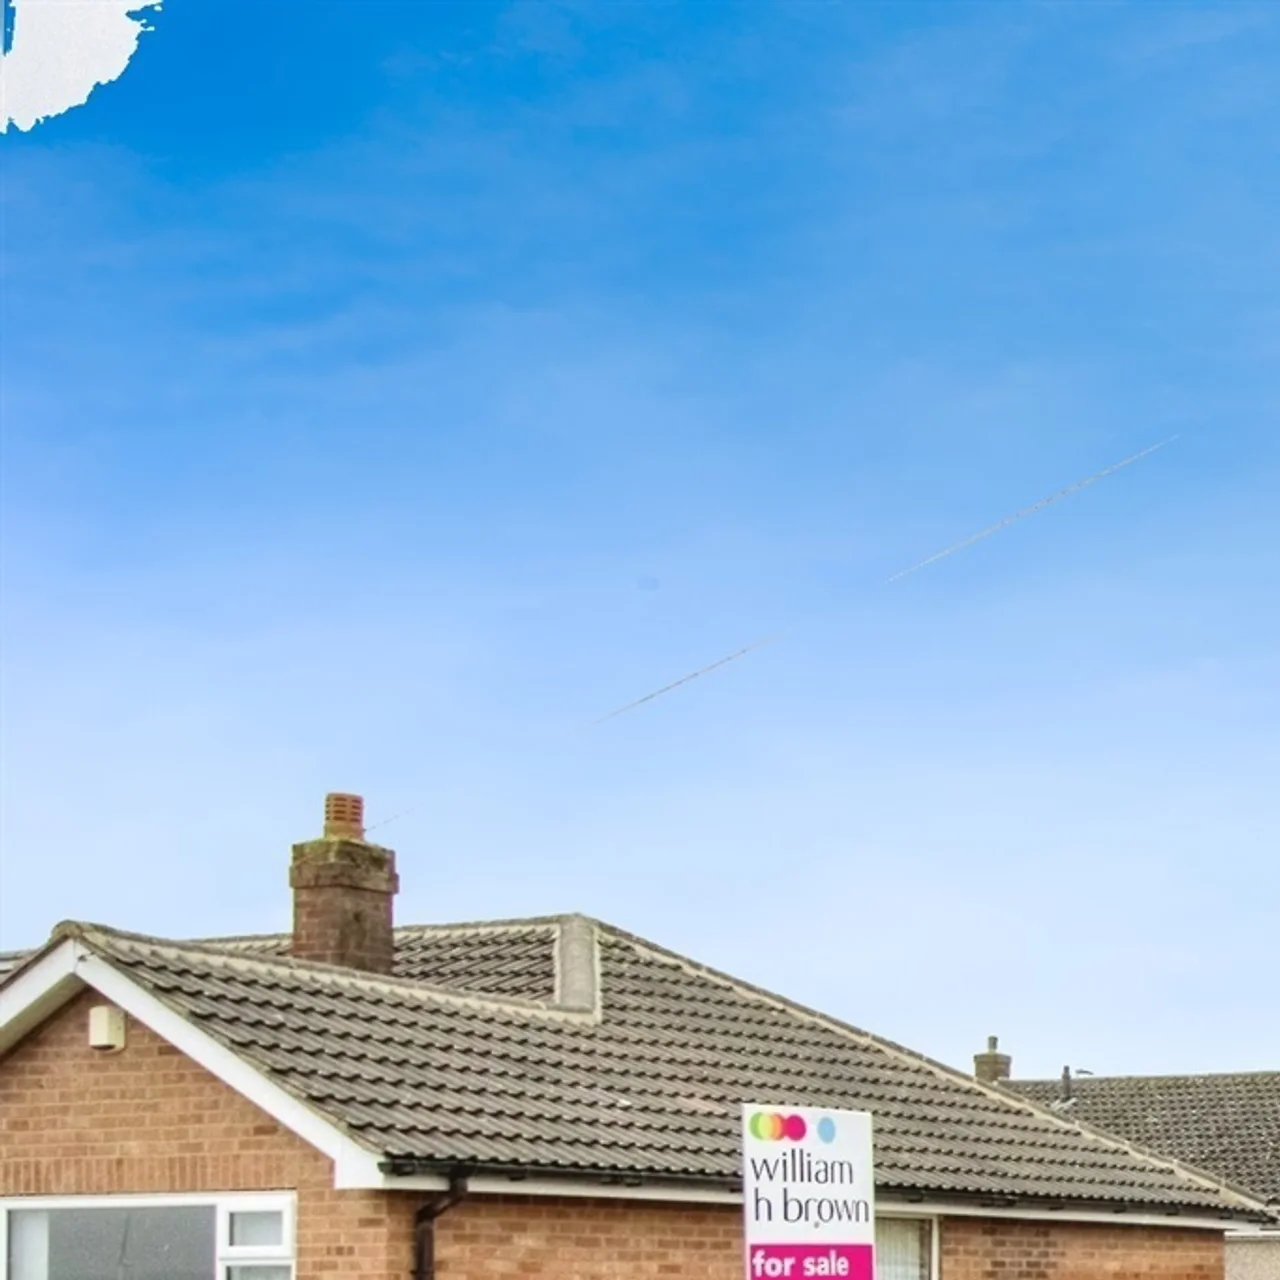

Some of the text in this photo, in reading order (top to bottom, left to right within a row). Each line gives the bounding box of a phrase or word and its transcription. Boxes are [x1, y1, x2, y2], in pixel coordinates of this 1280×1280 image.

[750, 1148, 853, 1184] william
[755, 1187, 869, 1223] h brown
[752, 1250, 849, 1277] for sale
